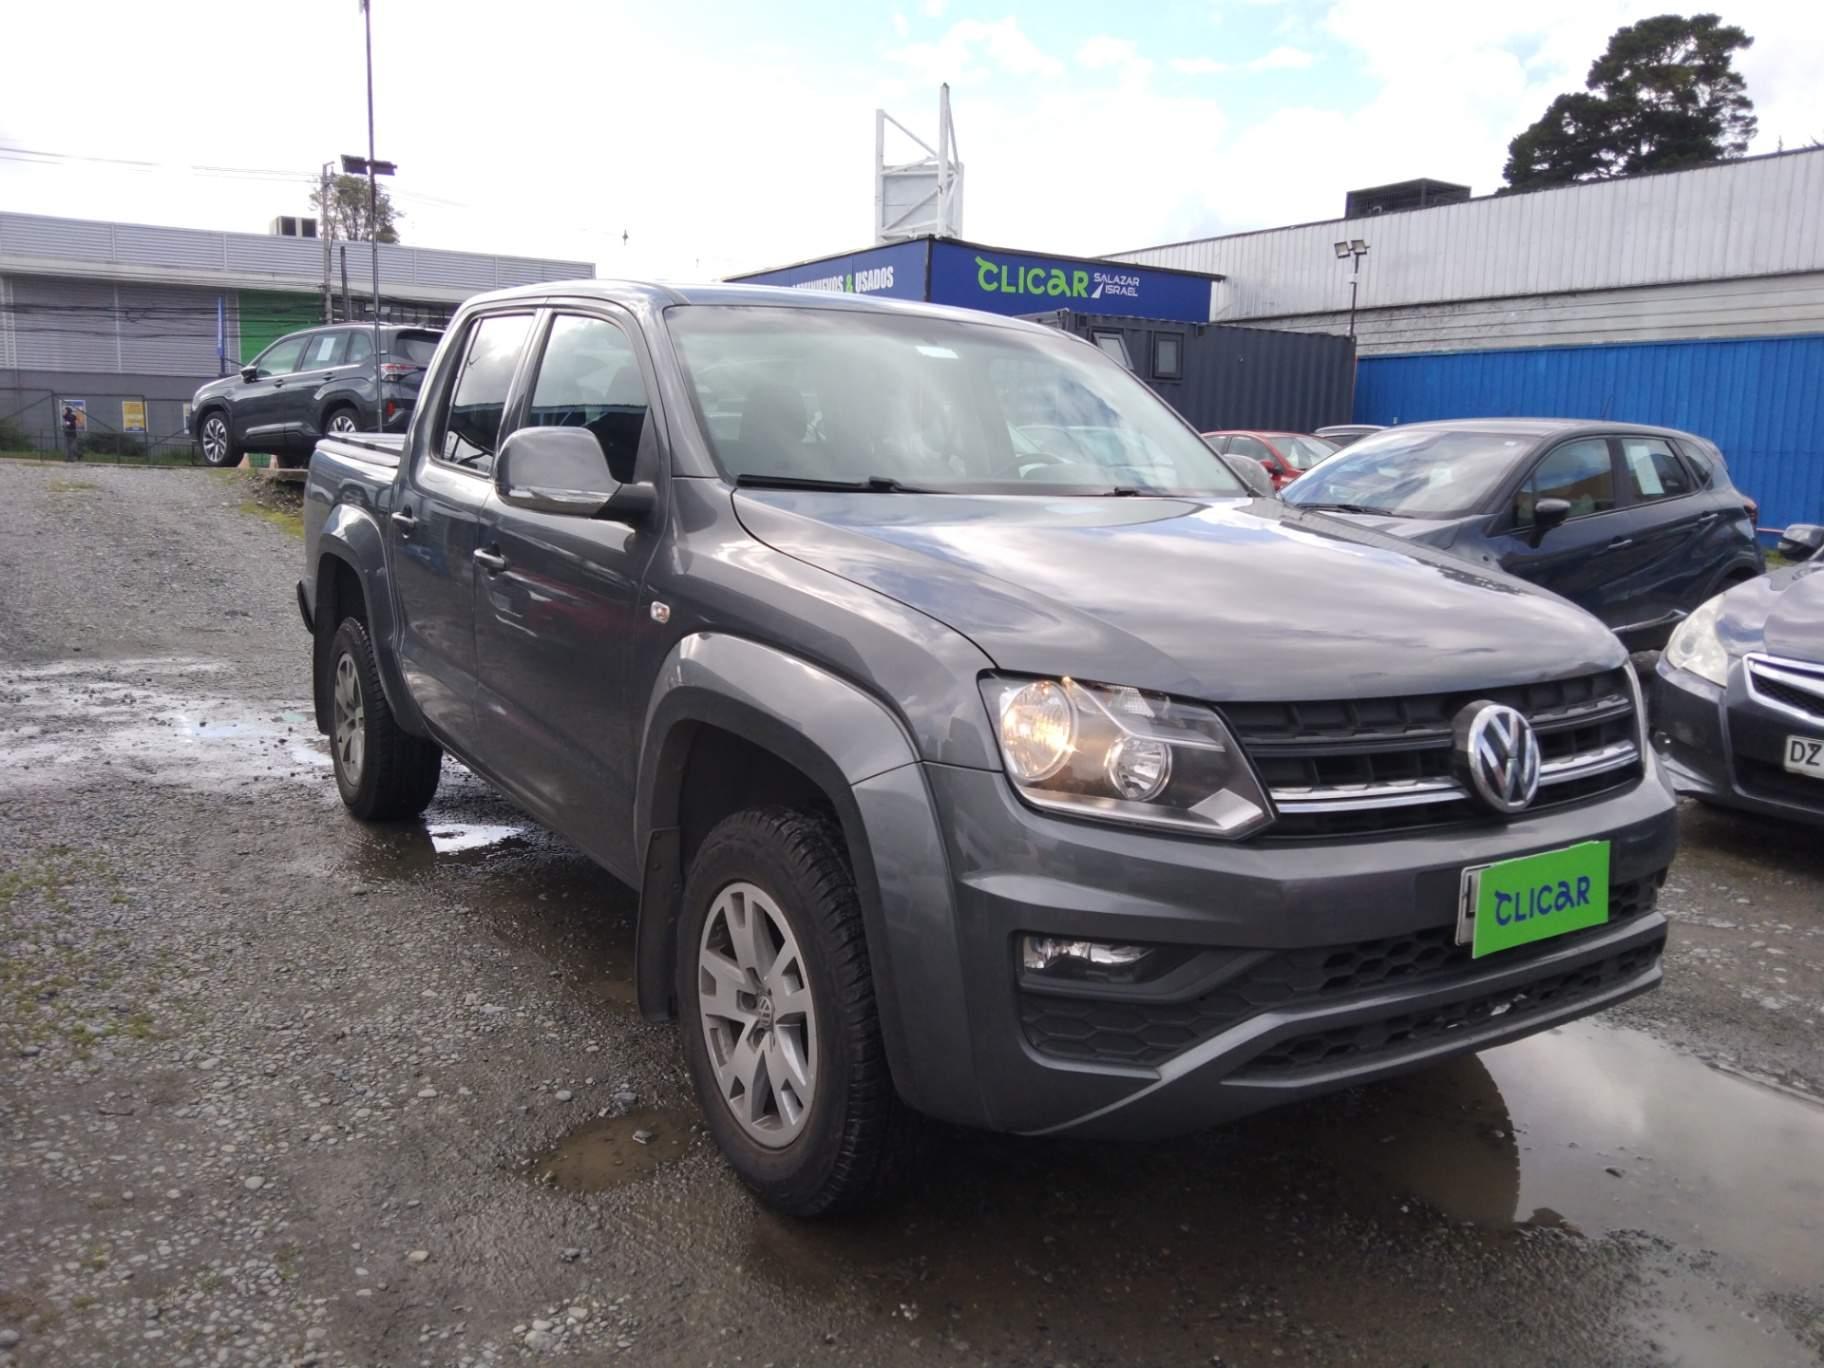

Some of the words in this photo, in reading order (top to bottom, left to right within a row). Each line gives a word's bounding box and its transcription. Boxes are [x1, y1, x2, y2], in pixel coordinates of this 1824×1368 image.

[855, 266, 894, 293] USADOS
[1094, 272, 1140, 287] SALAZAR
[1105, 285, 1138, 297] ISRAEL
[1790, 740, 1823, 767] DZ
